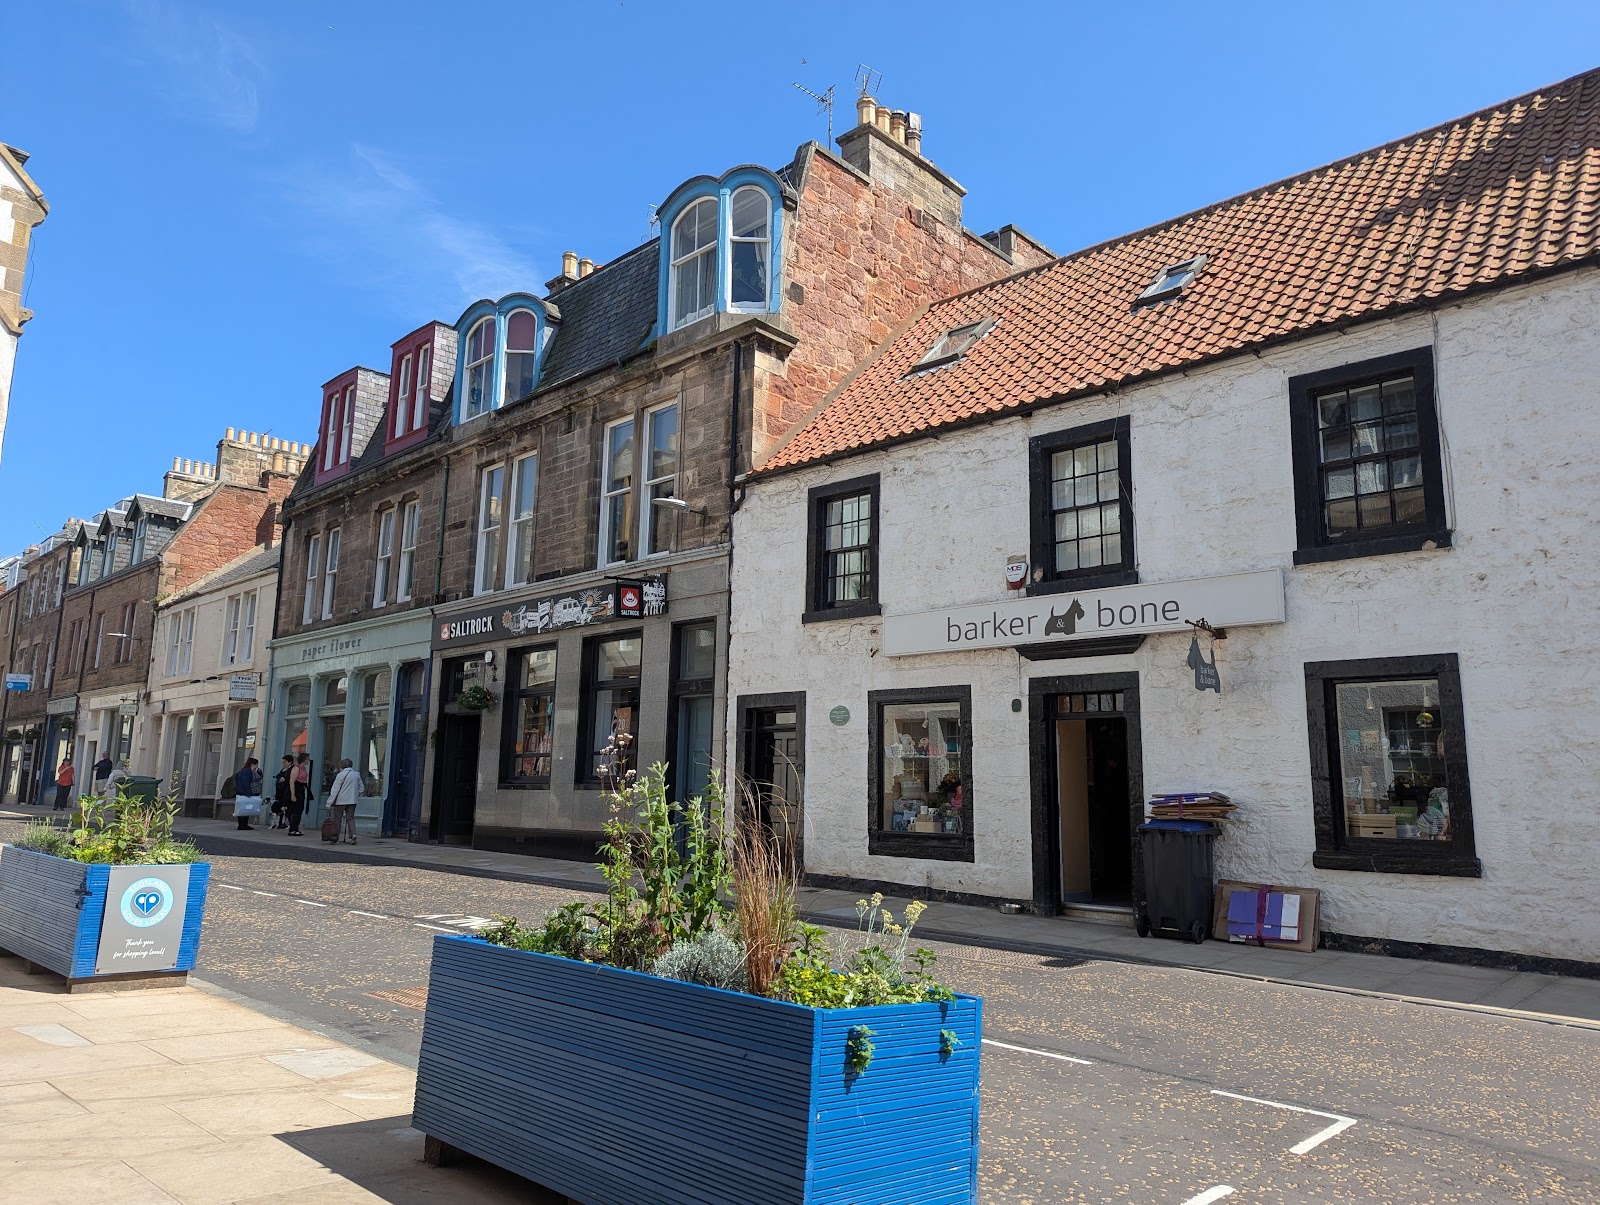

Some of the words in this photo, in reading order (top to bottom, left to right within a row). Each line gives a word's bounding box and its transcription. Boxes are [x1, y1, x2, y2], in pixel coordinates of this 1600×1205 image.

[450, 616, 493, 638] SALTROCK
[947, 611, 1038, 643] barker
[1056, 618, 1066, 628] &
[1097, 599, 1180, 628] bone
[302, 645, 326, 660] paper
[330, 639, 362, 652] flower
[1200, 665, 1215, 675] barker
[1205, 675, 1216, 685] bone
[689, 681, 702, 693] 43
[129, 880, 168, 893] SCOTLAND
[123, 909, 143, 926] LOVES
[145, 908, 168, 925] LOCAL
[125, 938, 142, 948] Thank
[142, 940, 154, 948] you
[112, 951, 122, 960] for
[123, 949, 148, 959] shopping
[149, 947, 166, 957] local!
